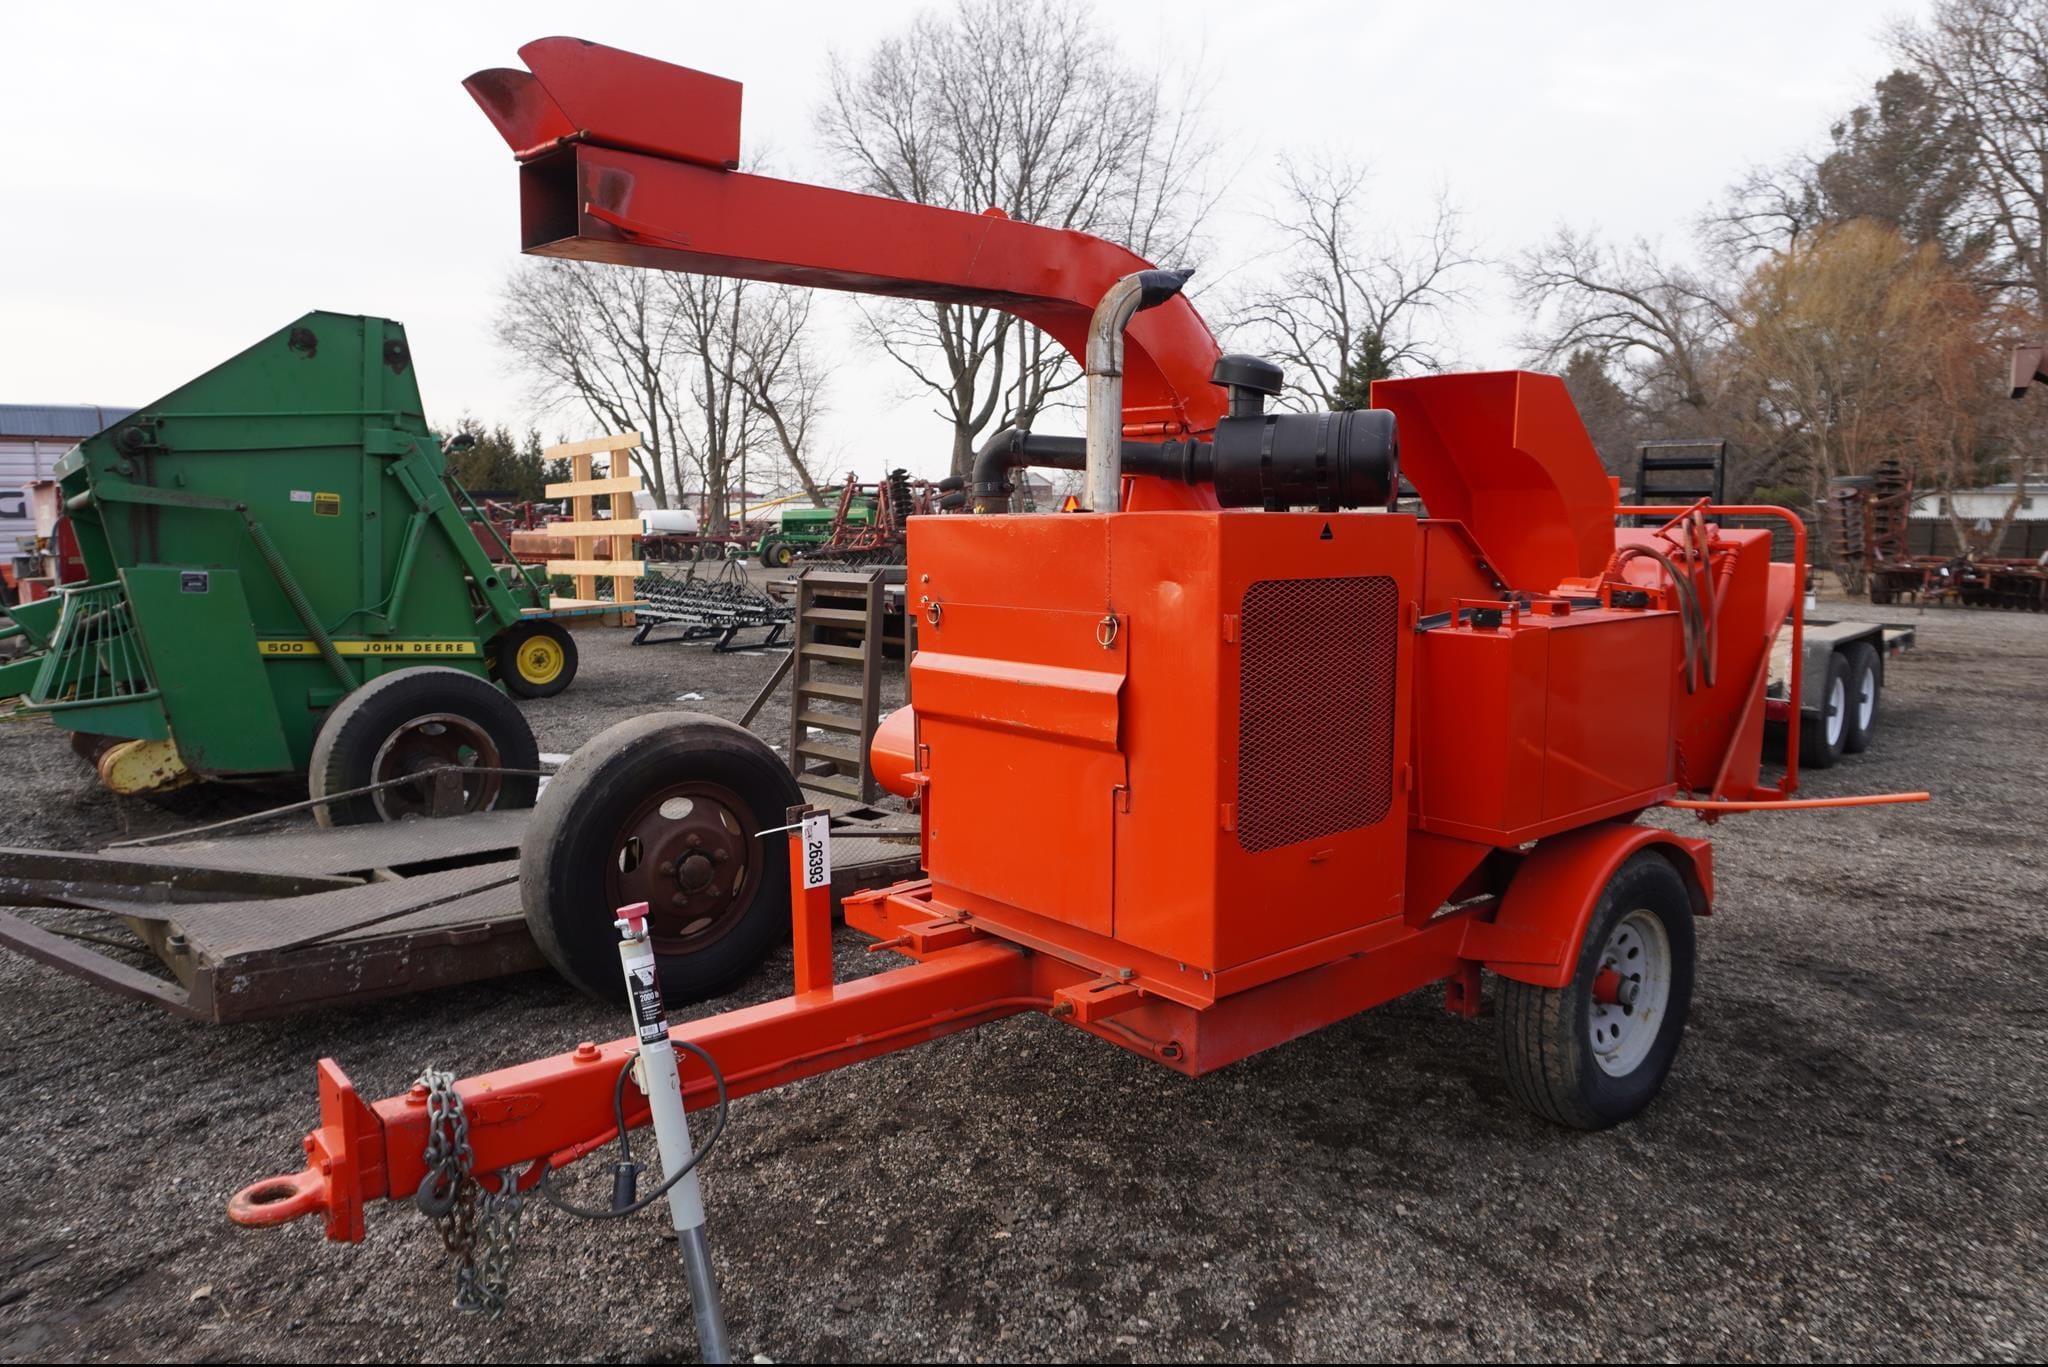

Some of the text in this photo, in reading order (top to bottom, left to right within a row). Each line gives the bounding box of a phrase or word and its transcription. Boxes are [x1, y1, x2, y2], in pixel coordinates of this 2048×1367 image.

[268, 643, 303, 652] 500
[363, 643, 464, 652] JOHN DEERE
[809, 841, 823, 884] 26393
[640, 992, 655, 1002] 2000
